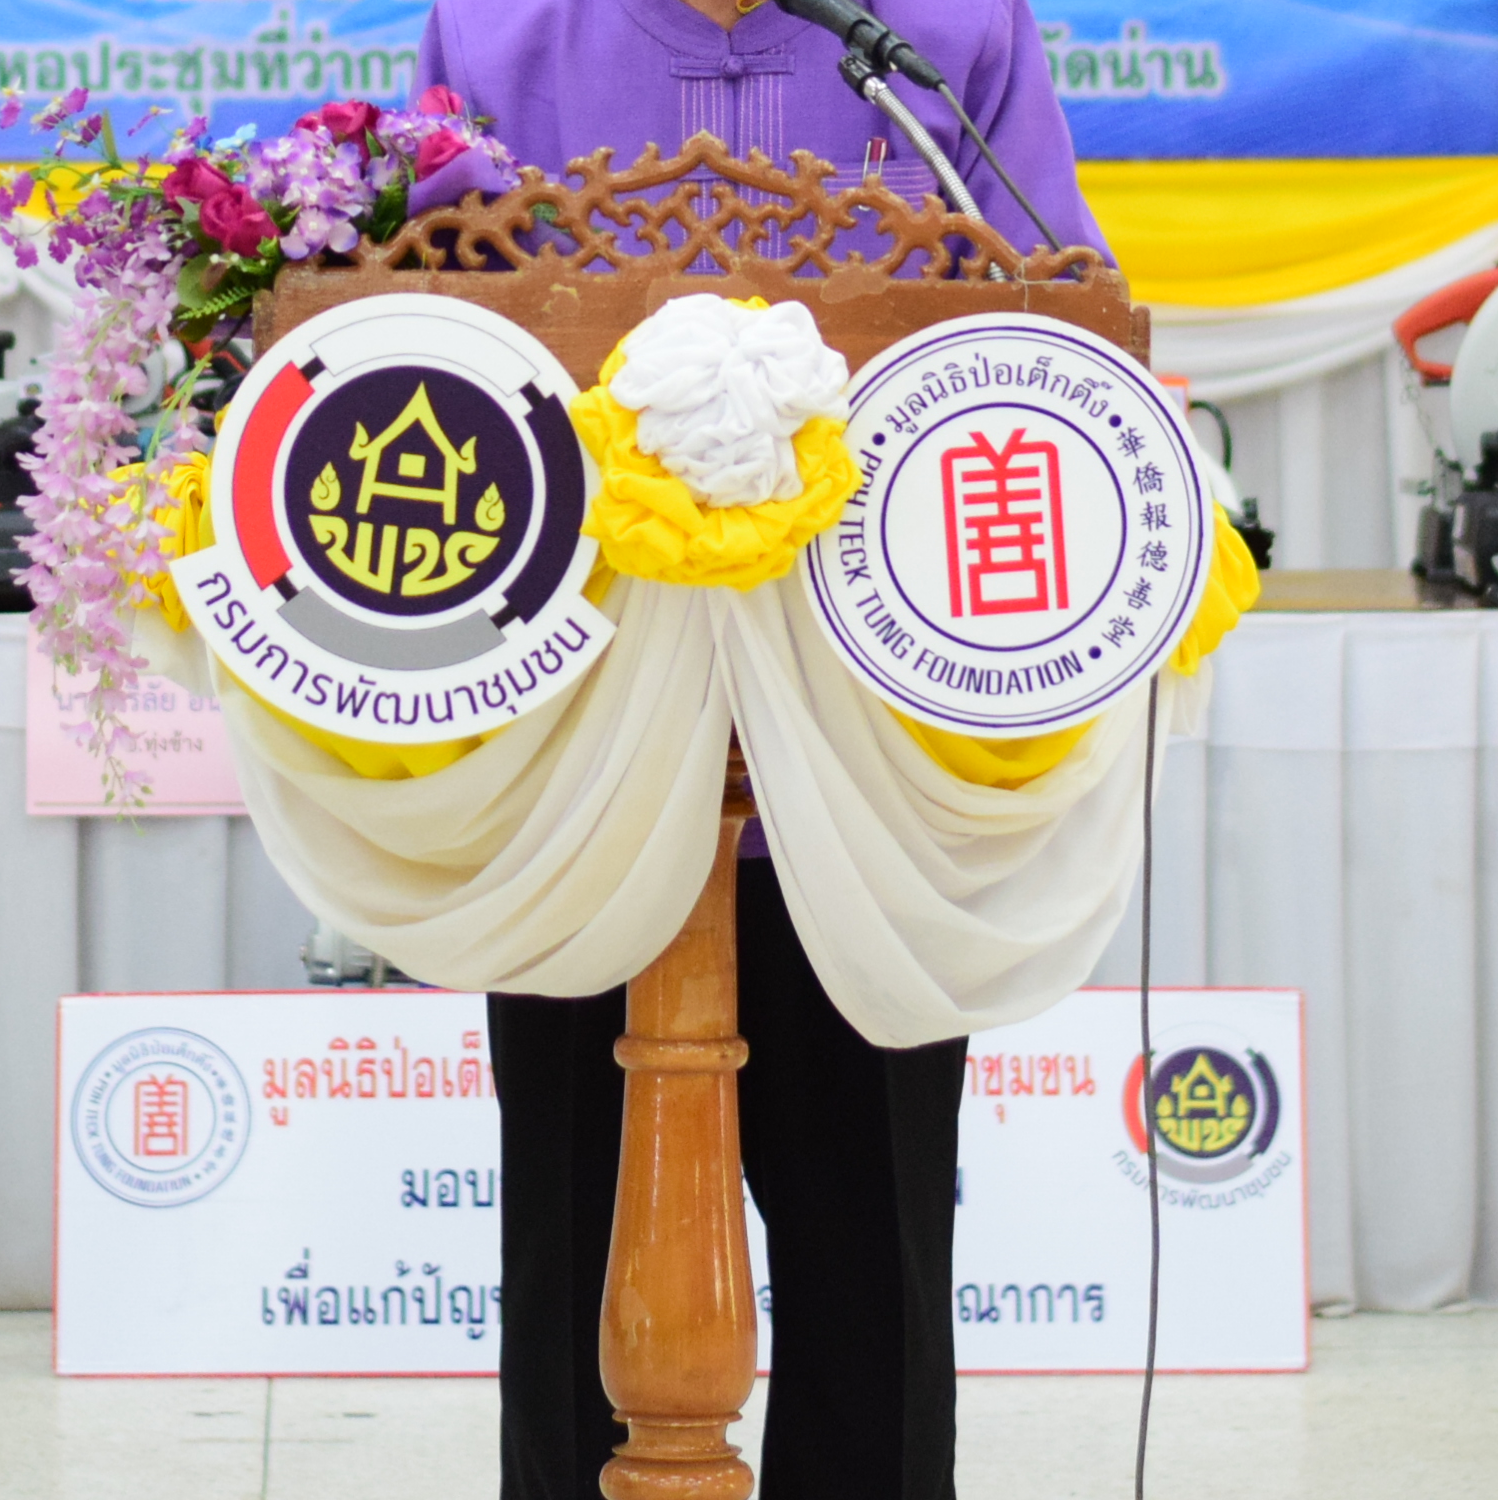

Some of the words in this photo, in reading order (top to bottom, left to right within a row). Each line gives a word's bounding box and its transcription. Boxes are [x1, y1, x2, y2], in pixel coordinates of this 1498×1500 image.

[885, 353, 1113, 435] มูลนิธิป่อเต็กตึ๊ง
[838, 515, 872, 586] TECK
[855, 588, 916, 660] TUNG
[911, 649, 1085, 696] FOUNDATION
[1101, 426, 1173, 649] 華僑報德善堂
[196, 570, 591, 726] กรมการพัฒนาชุมชน
